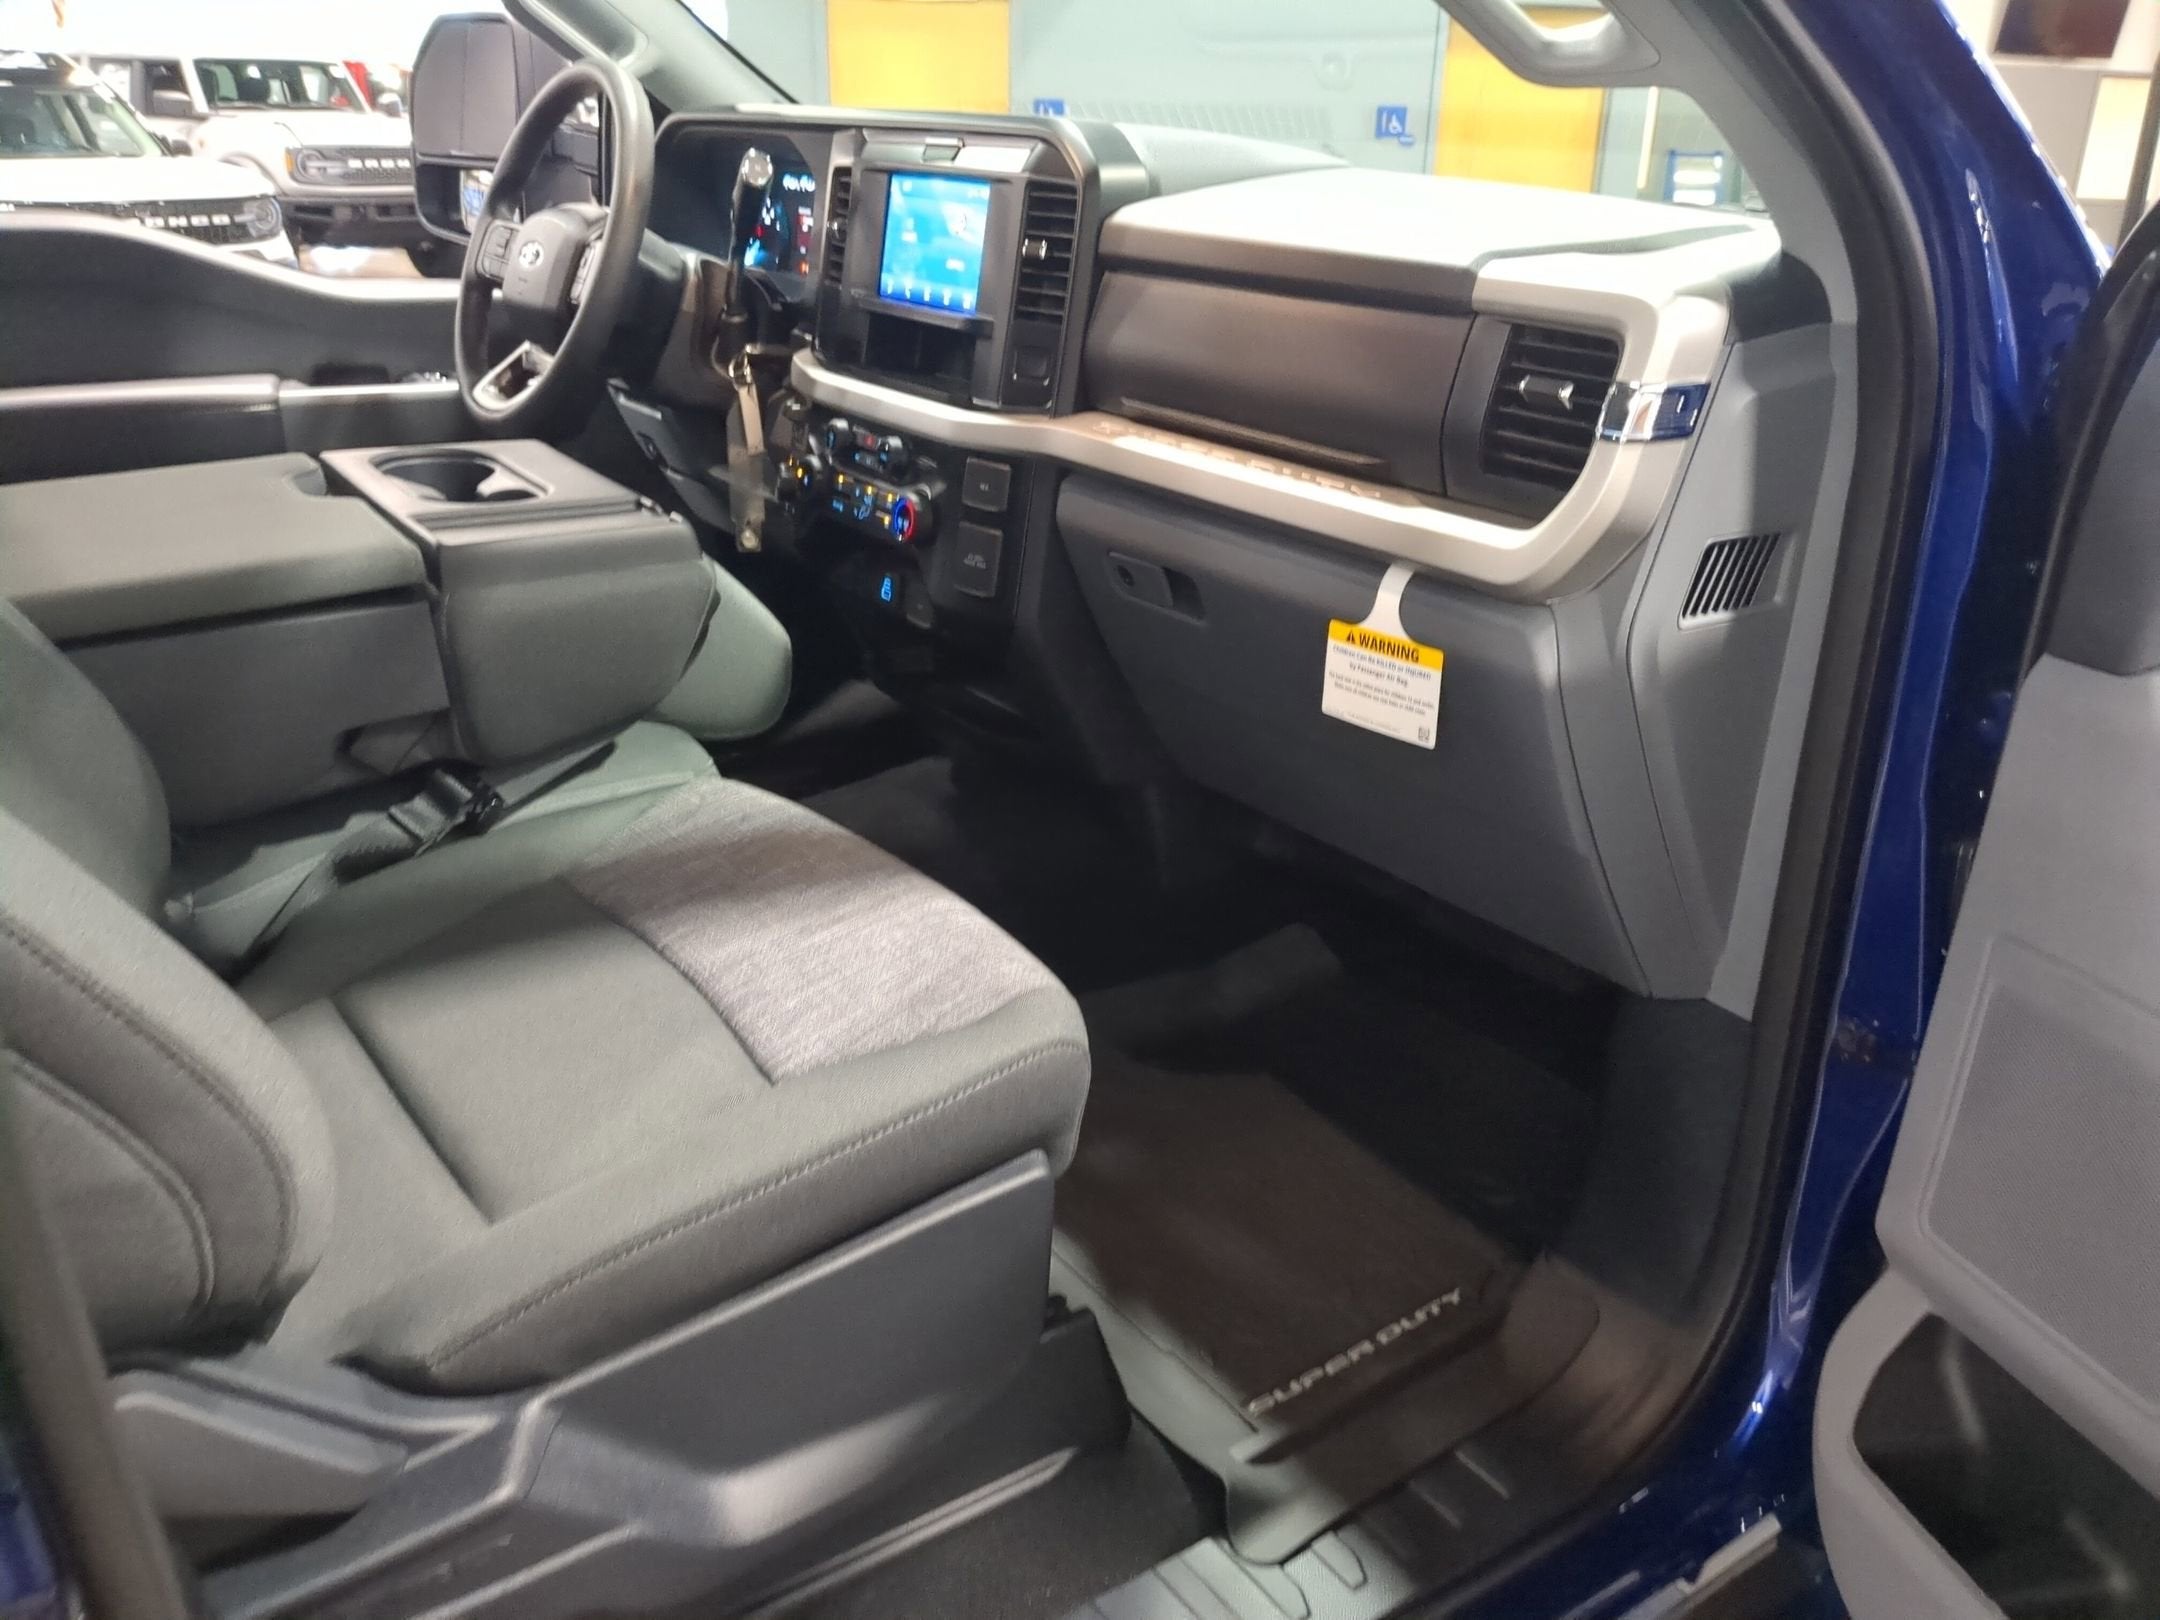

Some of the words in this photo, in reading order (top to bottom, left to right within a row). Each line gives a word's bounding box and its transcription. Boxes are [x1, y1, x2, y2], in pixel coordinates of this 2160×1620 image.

[348, 159, 411, 168] BRON
[1359, 632, 1420, 663] WARNING
[1248, 1339, 1376, 1417] SUPER
[1376, 1287, 1461, 1346] DUTY
